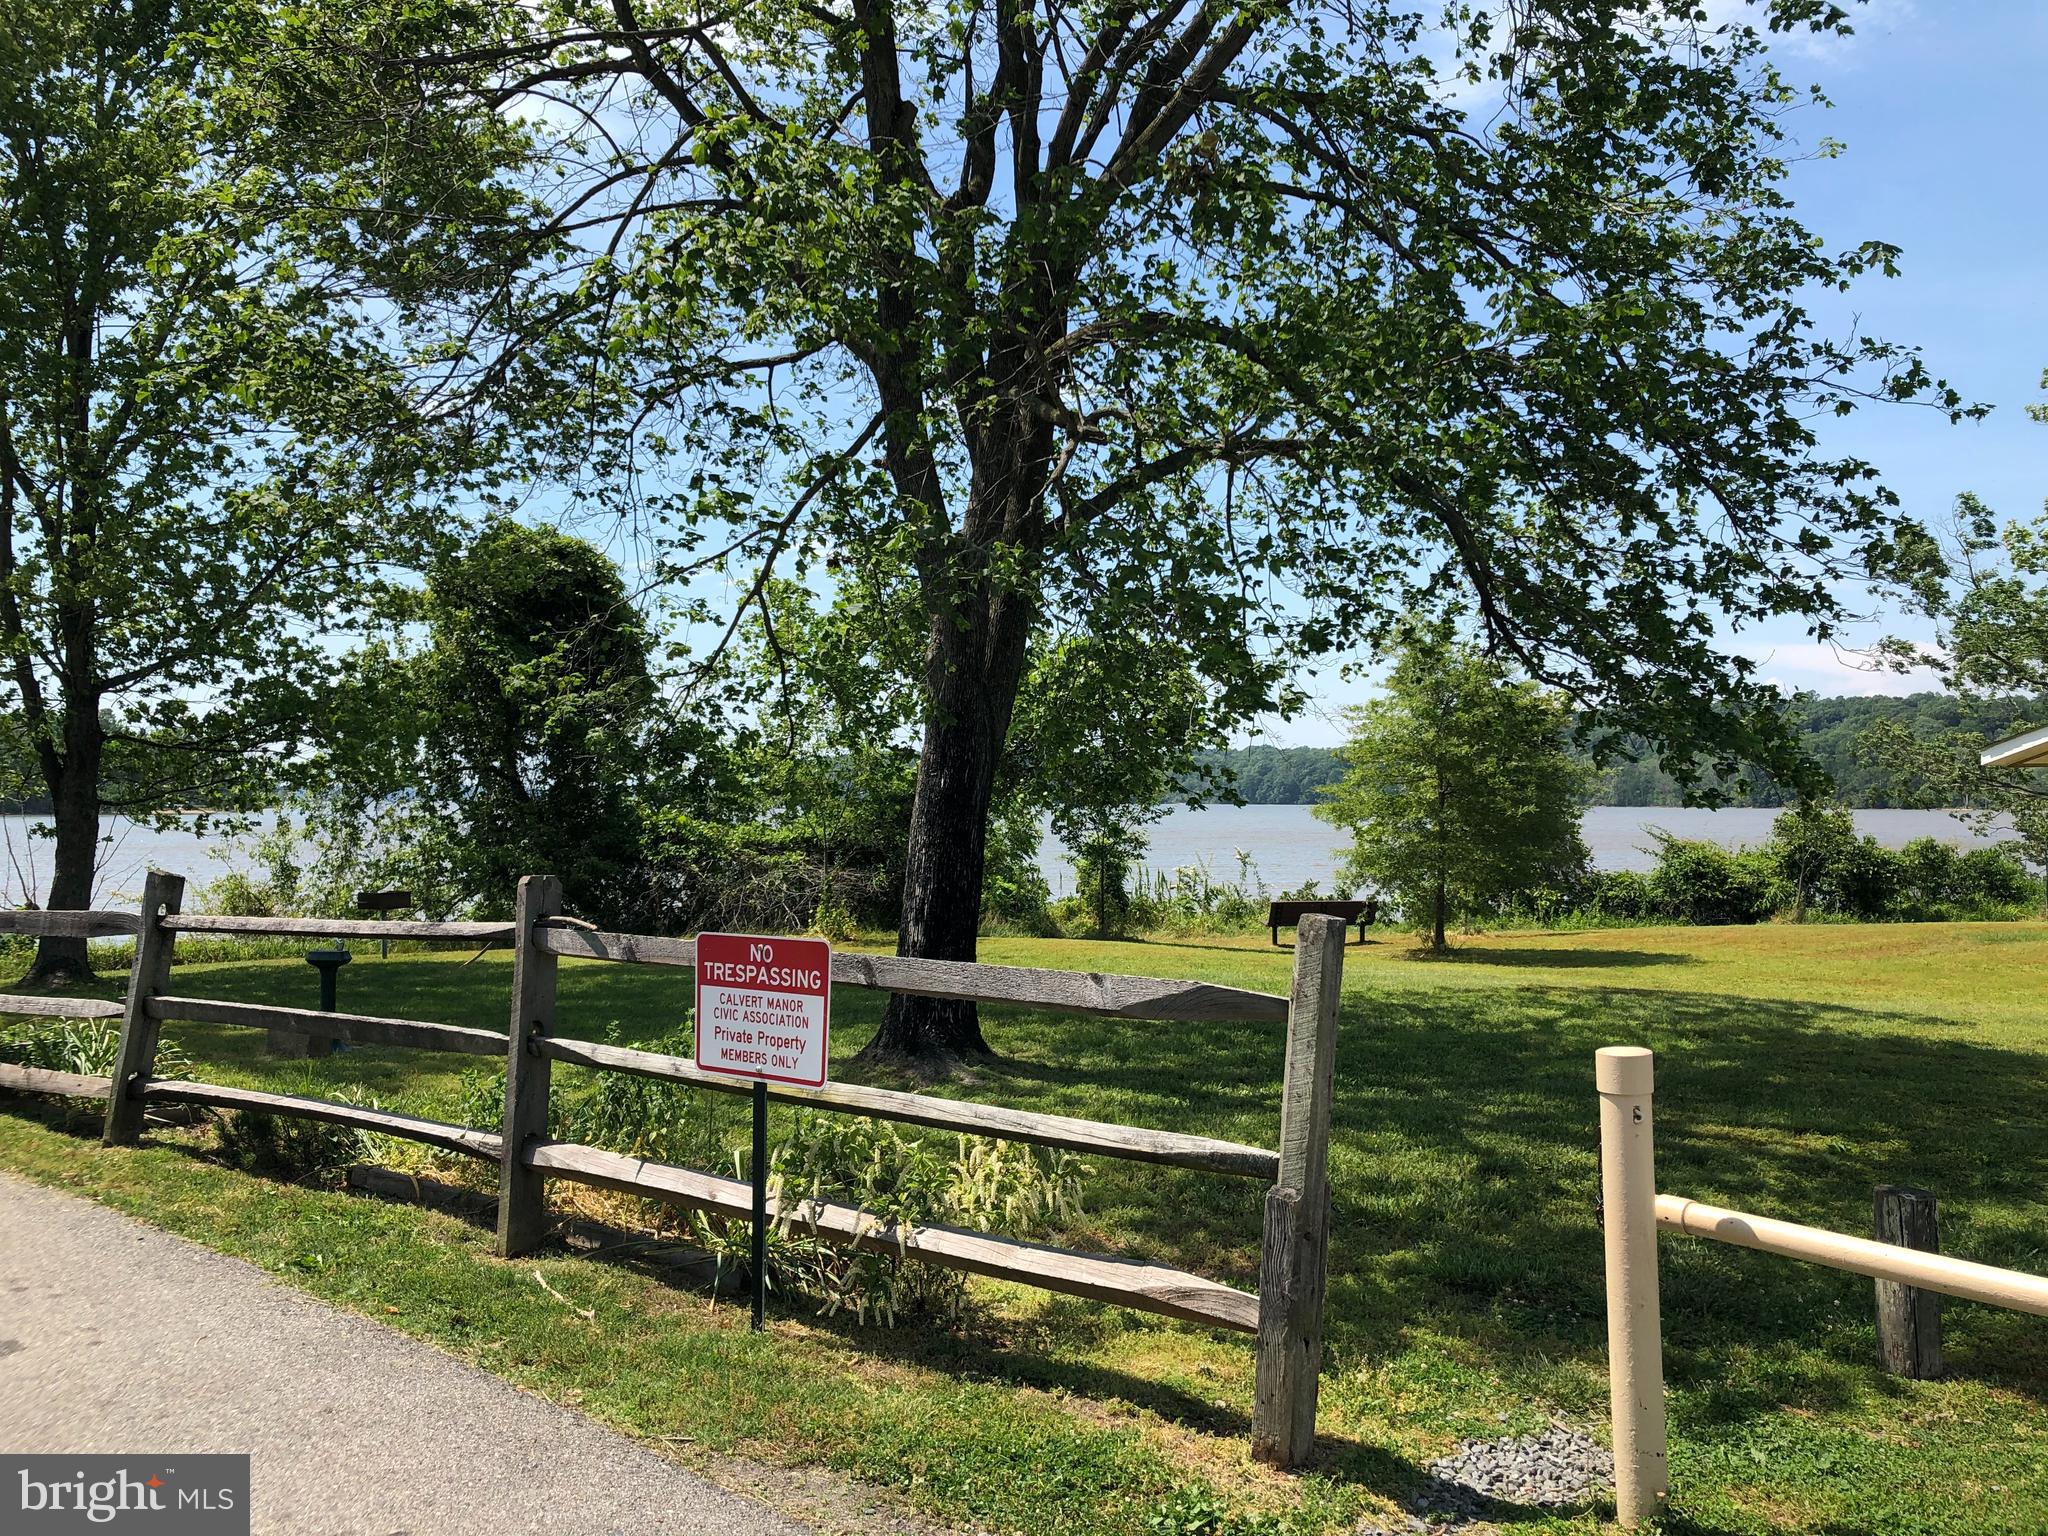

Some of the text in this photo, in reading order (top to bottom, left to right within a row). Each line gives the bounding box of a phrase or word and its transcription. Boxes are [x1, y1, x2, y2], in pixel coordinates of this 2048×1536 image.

[750, 944, 773, 963] NO
[704, 962, 821, 989] TRESPASSING
[719, 992, 803, 1013] CALVERT MANOR
[713, 1007, 809, 1029] CIVIC ASSOCIATION
[714, 1026, 806, 1054] Private Property
[720, 1048, 799, 1070] MEMBERS ONLY
